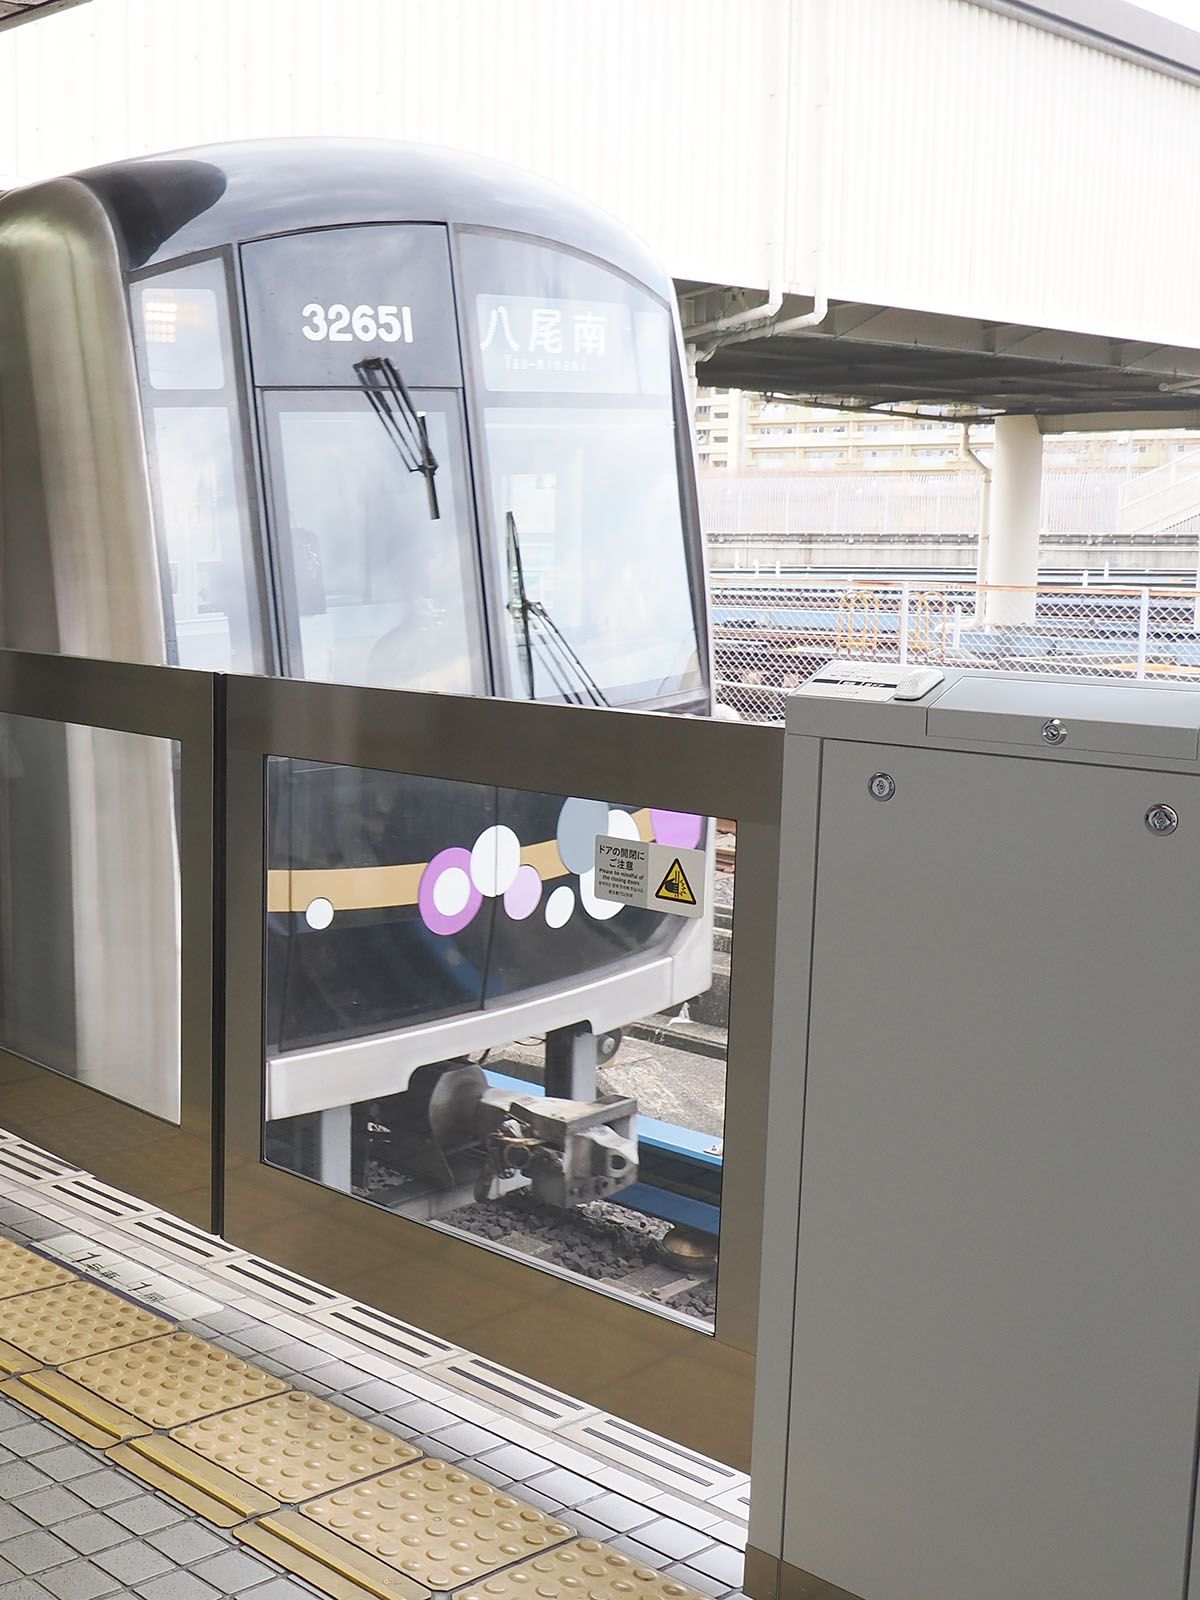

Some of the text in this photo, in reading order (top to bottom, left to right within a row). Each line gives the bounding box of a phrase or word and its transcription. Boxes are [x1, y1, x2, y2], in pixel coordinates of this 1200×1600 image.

[301, 303, 414, 343] 32651
[480, 306, 606, 355] 八尾南
[599, 845, 645, 860] ドアの開閉に
[609, 858, 633, 870] ご注意
